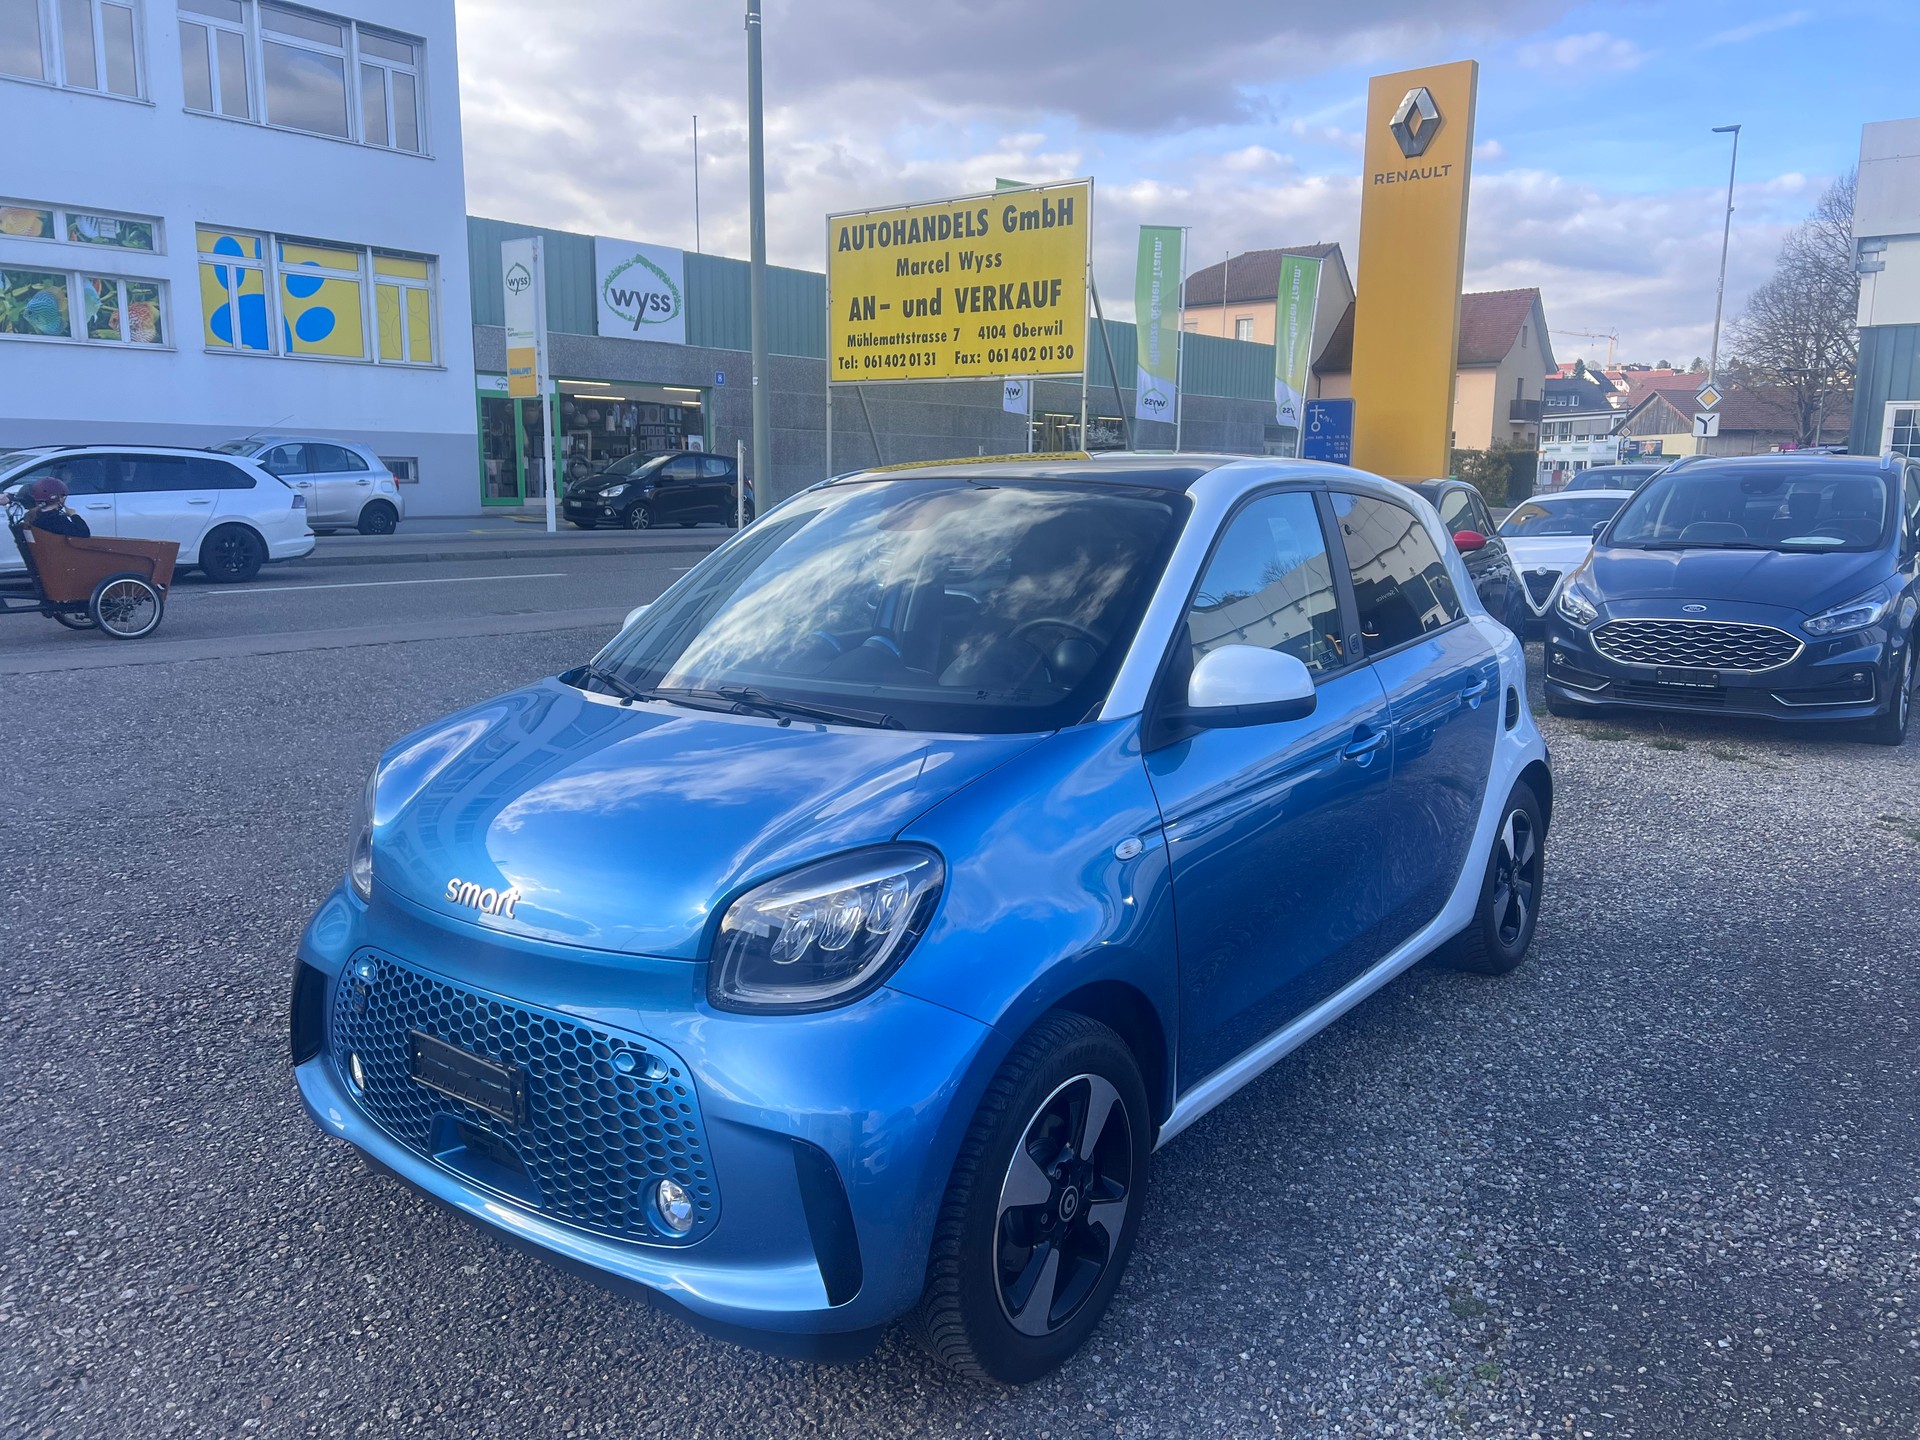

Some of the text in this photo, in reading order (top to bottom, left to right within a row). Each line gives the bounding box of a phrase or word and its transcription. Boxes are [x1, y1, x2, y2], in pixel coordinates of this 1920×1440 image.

[1374, 164, 1452, 185] RENAULT
[838, 197, 1074, 252] AUTOHANDELS GmbH
[896, 250, 1002, 277] Marcel Wyss
[507, 276, 528, 296] wyss
[902, 287, 942, 318] und
[954, 279, 1062, 314] VERKAUF
[610, 288, 671, 331] wyss
[847, 320, 1063, 348] Mühlemattstrasse 7 4104 Oberwil
[838, 355, 858, 370] Tel:
[955, 351, 981, 365] Fax:
[717, 374, 723, 383] 8
[444, 878, 521, 919] smart
